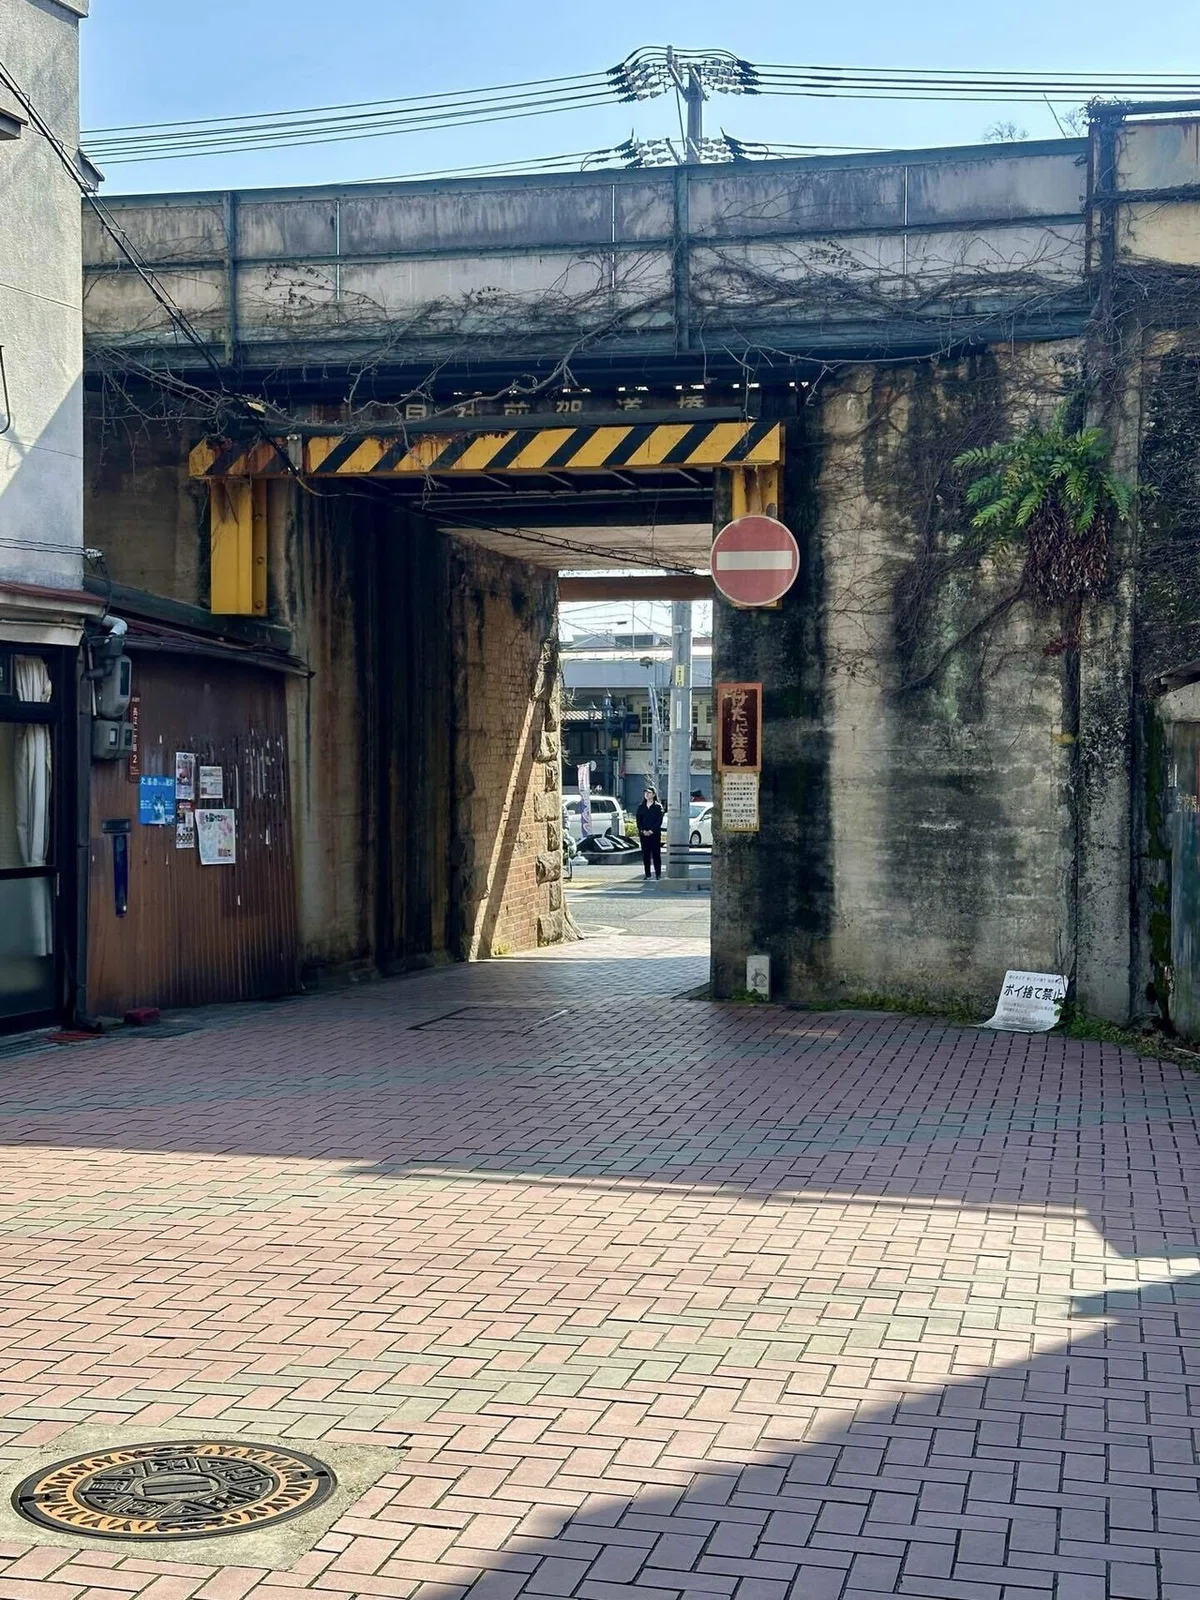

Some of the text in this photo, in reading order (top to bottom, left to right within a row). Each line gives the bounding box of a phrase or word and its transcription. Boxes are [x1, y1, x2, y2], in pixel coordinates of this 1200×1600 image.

[1004, 984, 1063, 1001] ポイ捨て禁止
